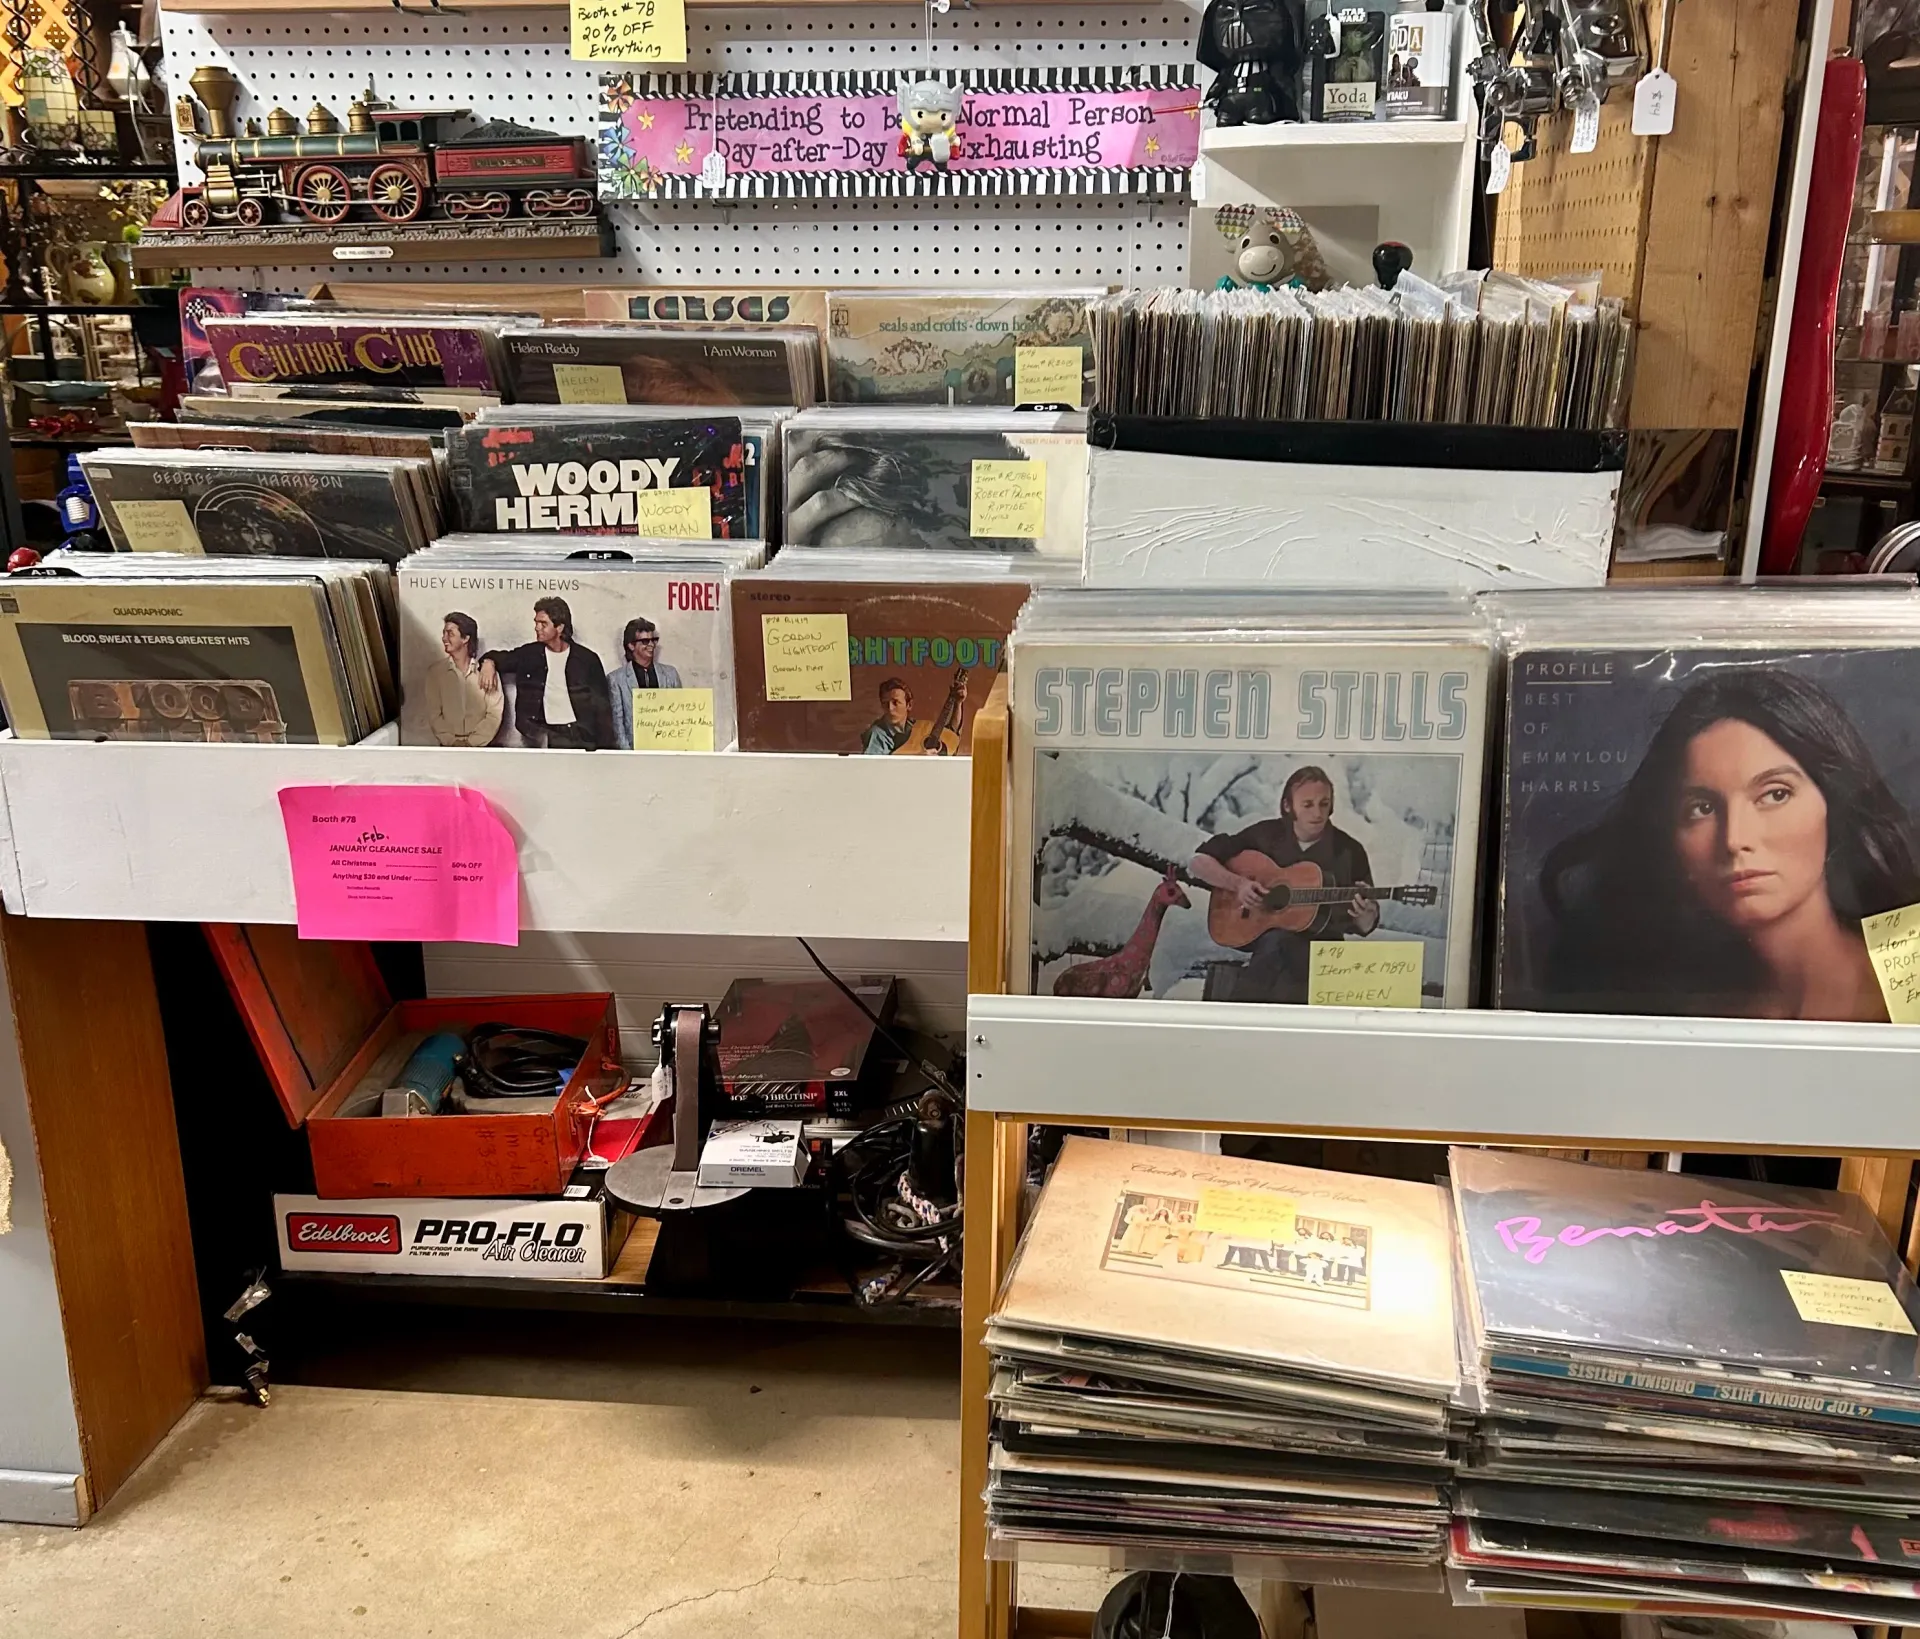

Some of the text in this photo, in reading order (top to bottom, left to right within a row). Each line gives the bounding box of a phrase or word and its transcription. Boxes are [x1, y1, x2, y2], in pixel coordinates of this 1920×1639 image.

[1338, 14, 1366, 23] WARS
[1341, 7, 1365, 16] STAR
[622, 21, 654, 37] OFF
[588, 40, 662, 58] Everything
[1327, 88, 1368, 104] Yoda
[684, 103, 823, 136] Pretending
[841, 106, 866, 130] to
[955, 97, 1051, 128] Normal
[1069, 97, 1156, 126] Person
[714, 131, 1103, 168] Day-after-Day Exhausting
[879, 318, 908, 333] seals
[909, 318, 931, 332] and
[932, 319, 968, 332] crofts
[975, 317, 1009, 332] down
[510, 342, 580, 357] Helen Reddy
[710, 345, 733, 357] Am
[733, 346, 777, 358] Woman
[228, 332, 443, 383] CULTURE CLUB
[560, 375, 599, 387] HELEN
[1033, 404, 1058, 412] O-P
[153, 471, 343, 489] GEORGE HARRISON
[511, 457, 681, 497] WOODY
[974, 487, 1010, 501] ROBERT
[495, 492, 638, 530] HERM
[641, 504, 692, 518] WOODY
[987, 501, 1028, 512] RIPTIDE
[642, 520, 700, 537] HERMAN
[588, 552, 613, 560] E-F
[409, 577, 580, 591] HUEY LEWIS THE NEWS
[667, 581, 721, 611] FORE!
[750, 592, 791, 602] stereo
[113, 607, 183, 617] QUADRAPHONIC
[62, 634, 251, 647] BLOOD, SWEAT & TEARS GREATEST HITS
[782, 640, 838, 656] LIGHTFOOT
[1525, 663, 1615, 675] PROFILE
[1034, 667, 1469, 741] STEPHEN STILLS
[1524, 692, 1575, 705] BEST
[1523, 722, 1550, 735] OF
[1521, 751, 1629, 764] EMMYLOU
[1520, 780, 1601, 793] HARRIS
[312, 815, 357, 823] Booth #78
[329, 845, 443, 854] JANUARY CLEARANCE SALE
[331, 859, 341, 867] All
[1889, 972, 1917, 991] Best
[1315, 986, 1392, 1004] STEPHEN
[770, 1093, 813, 1101] BRUTINI
[297, 1221, 391, 1244] Edelbrock
[413, 1219, 585, 1248] PRO-FLO
[482, 1238, 588, 1263] Air Cleaner
[1567, 1362, 1626, 1384] ARTISTS
[1629, 1371, 1696, 1394] ORIGINAL
[1758, 1390, 1825, 1412] ORIGINAL
[1826, 1400, 1858, 1416] TOP
